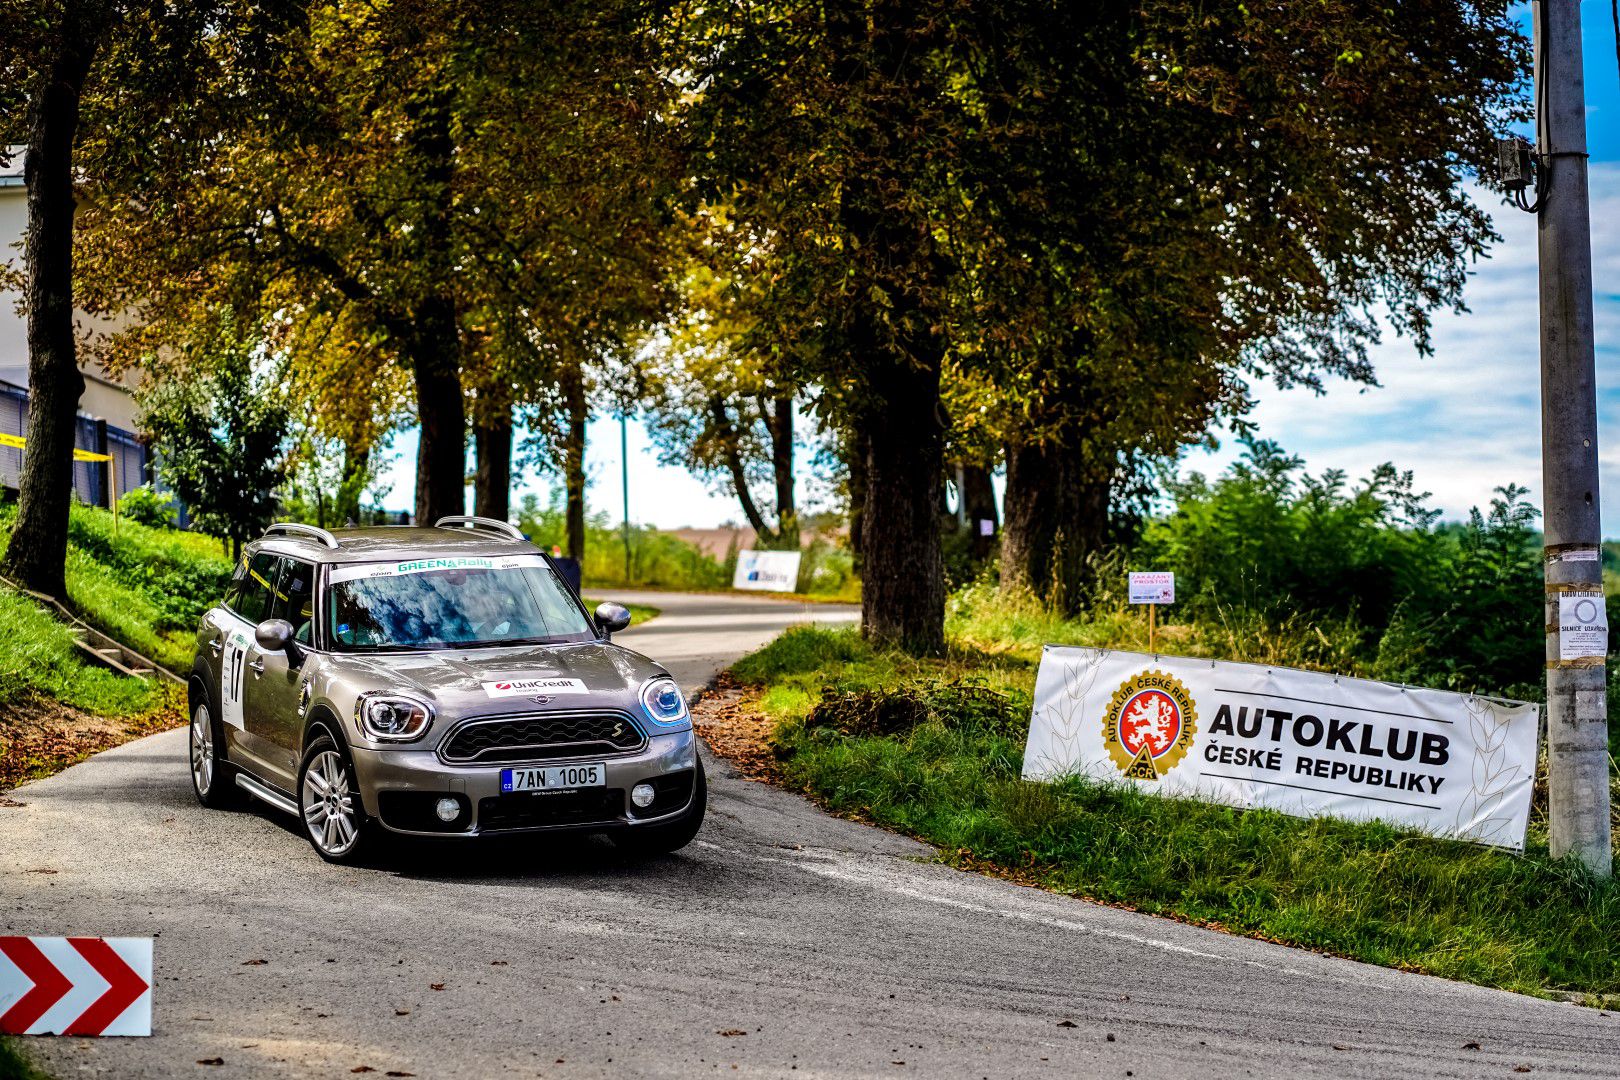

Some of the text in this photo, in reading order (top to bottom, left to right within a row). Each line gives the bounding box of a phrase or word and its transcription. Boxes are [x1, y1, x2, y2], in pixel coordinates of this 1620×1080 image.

[231, 647, 243, 702] 17
[512, 681, 574, 689] UniCredit
[1107, 677, 1193, 751] AUTOKLUB ČESKÉ REPUBLIKY
[1207, 704, 1451, 767] AUTOKLUB
[516, 770, 546, 789] 7AN
[559, 766, 597, 786] 1005
[1203, 740, 1446, 795] ČESKÉ REPUBLIKY
